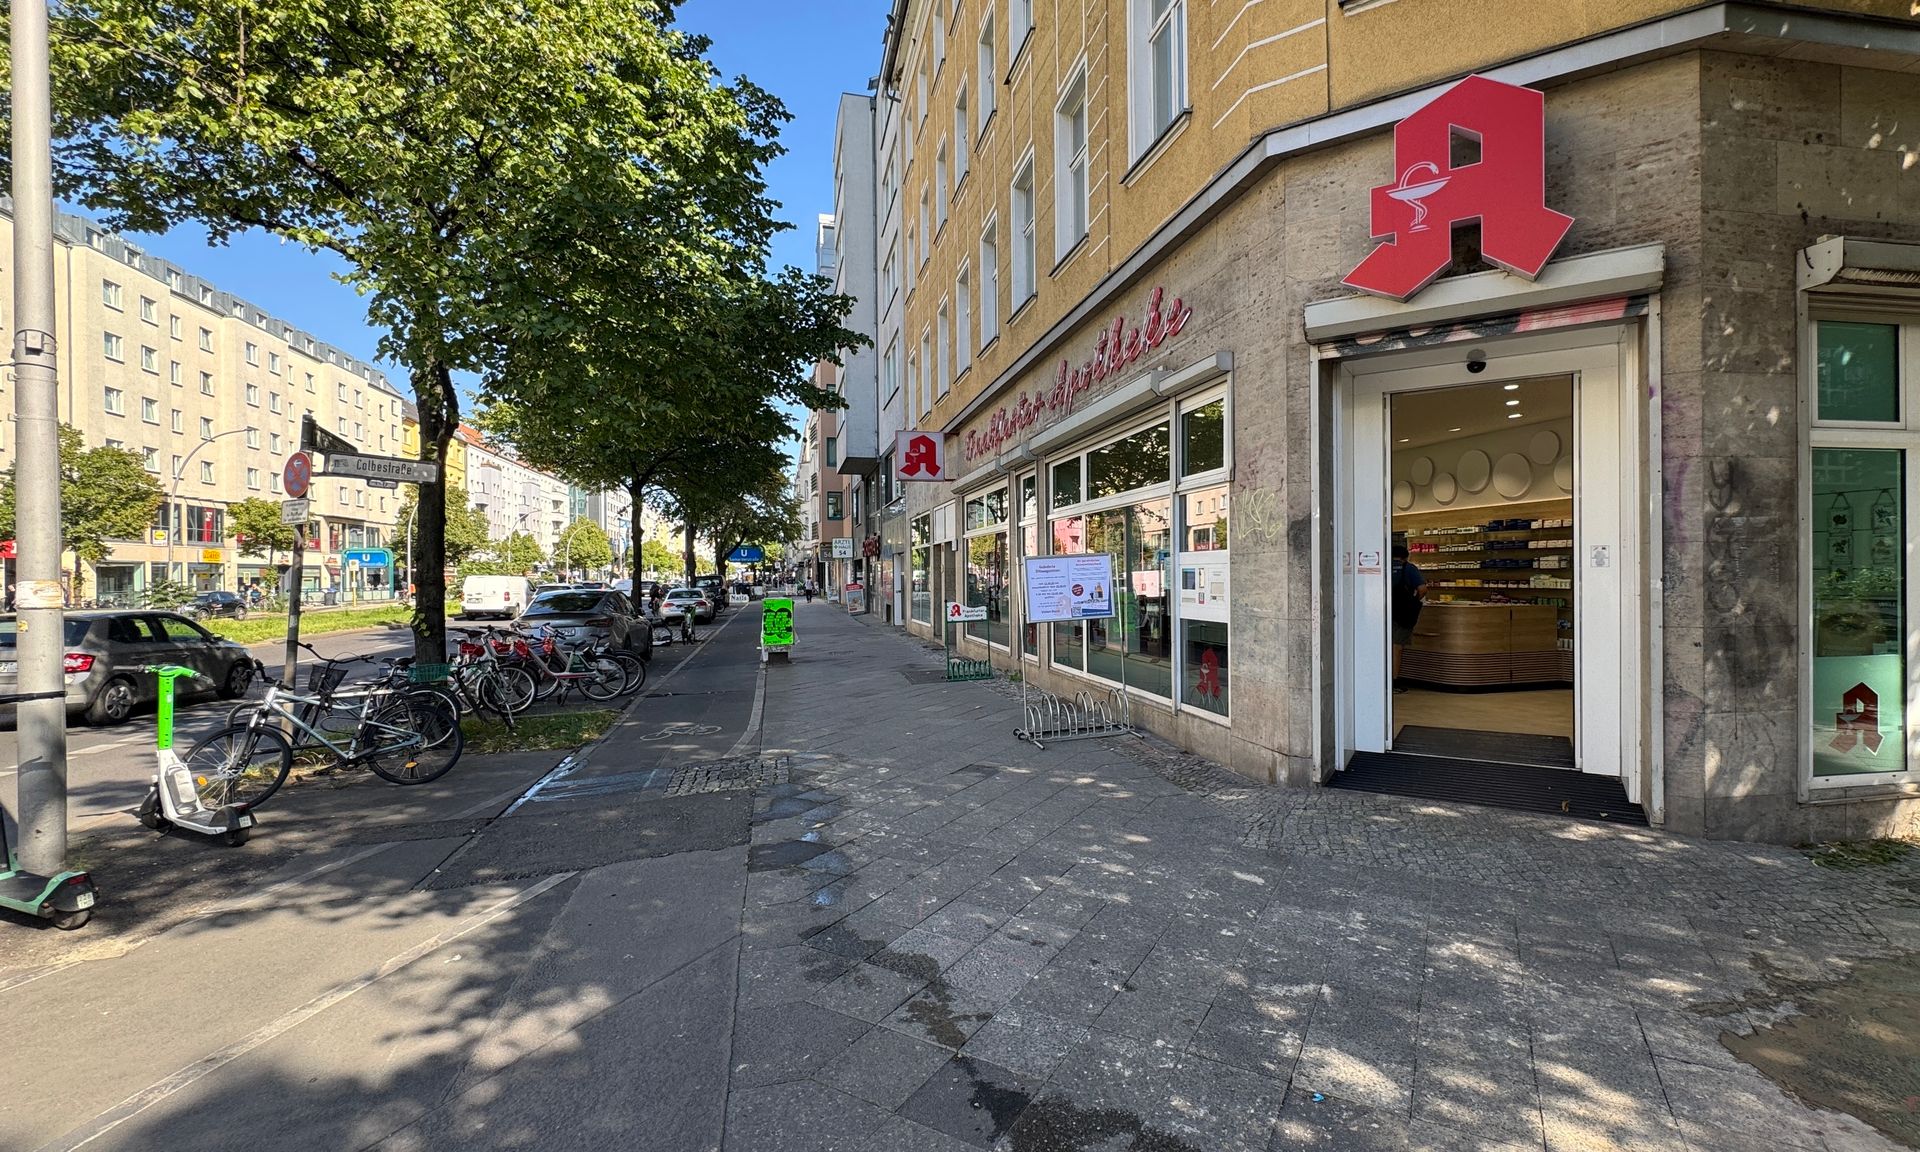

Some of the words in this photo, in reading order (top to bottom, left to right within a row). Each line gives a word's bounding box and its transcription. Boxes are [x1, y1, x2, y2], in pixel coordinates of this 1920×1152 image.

[1045, 286, 1193, 416] Apotheke
[356, 459, 412, 475] Colbestraße
[362, 553, 371, 562] U
[741, 549, 748, 557] U
